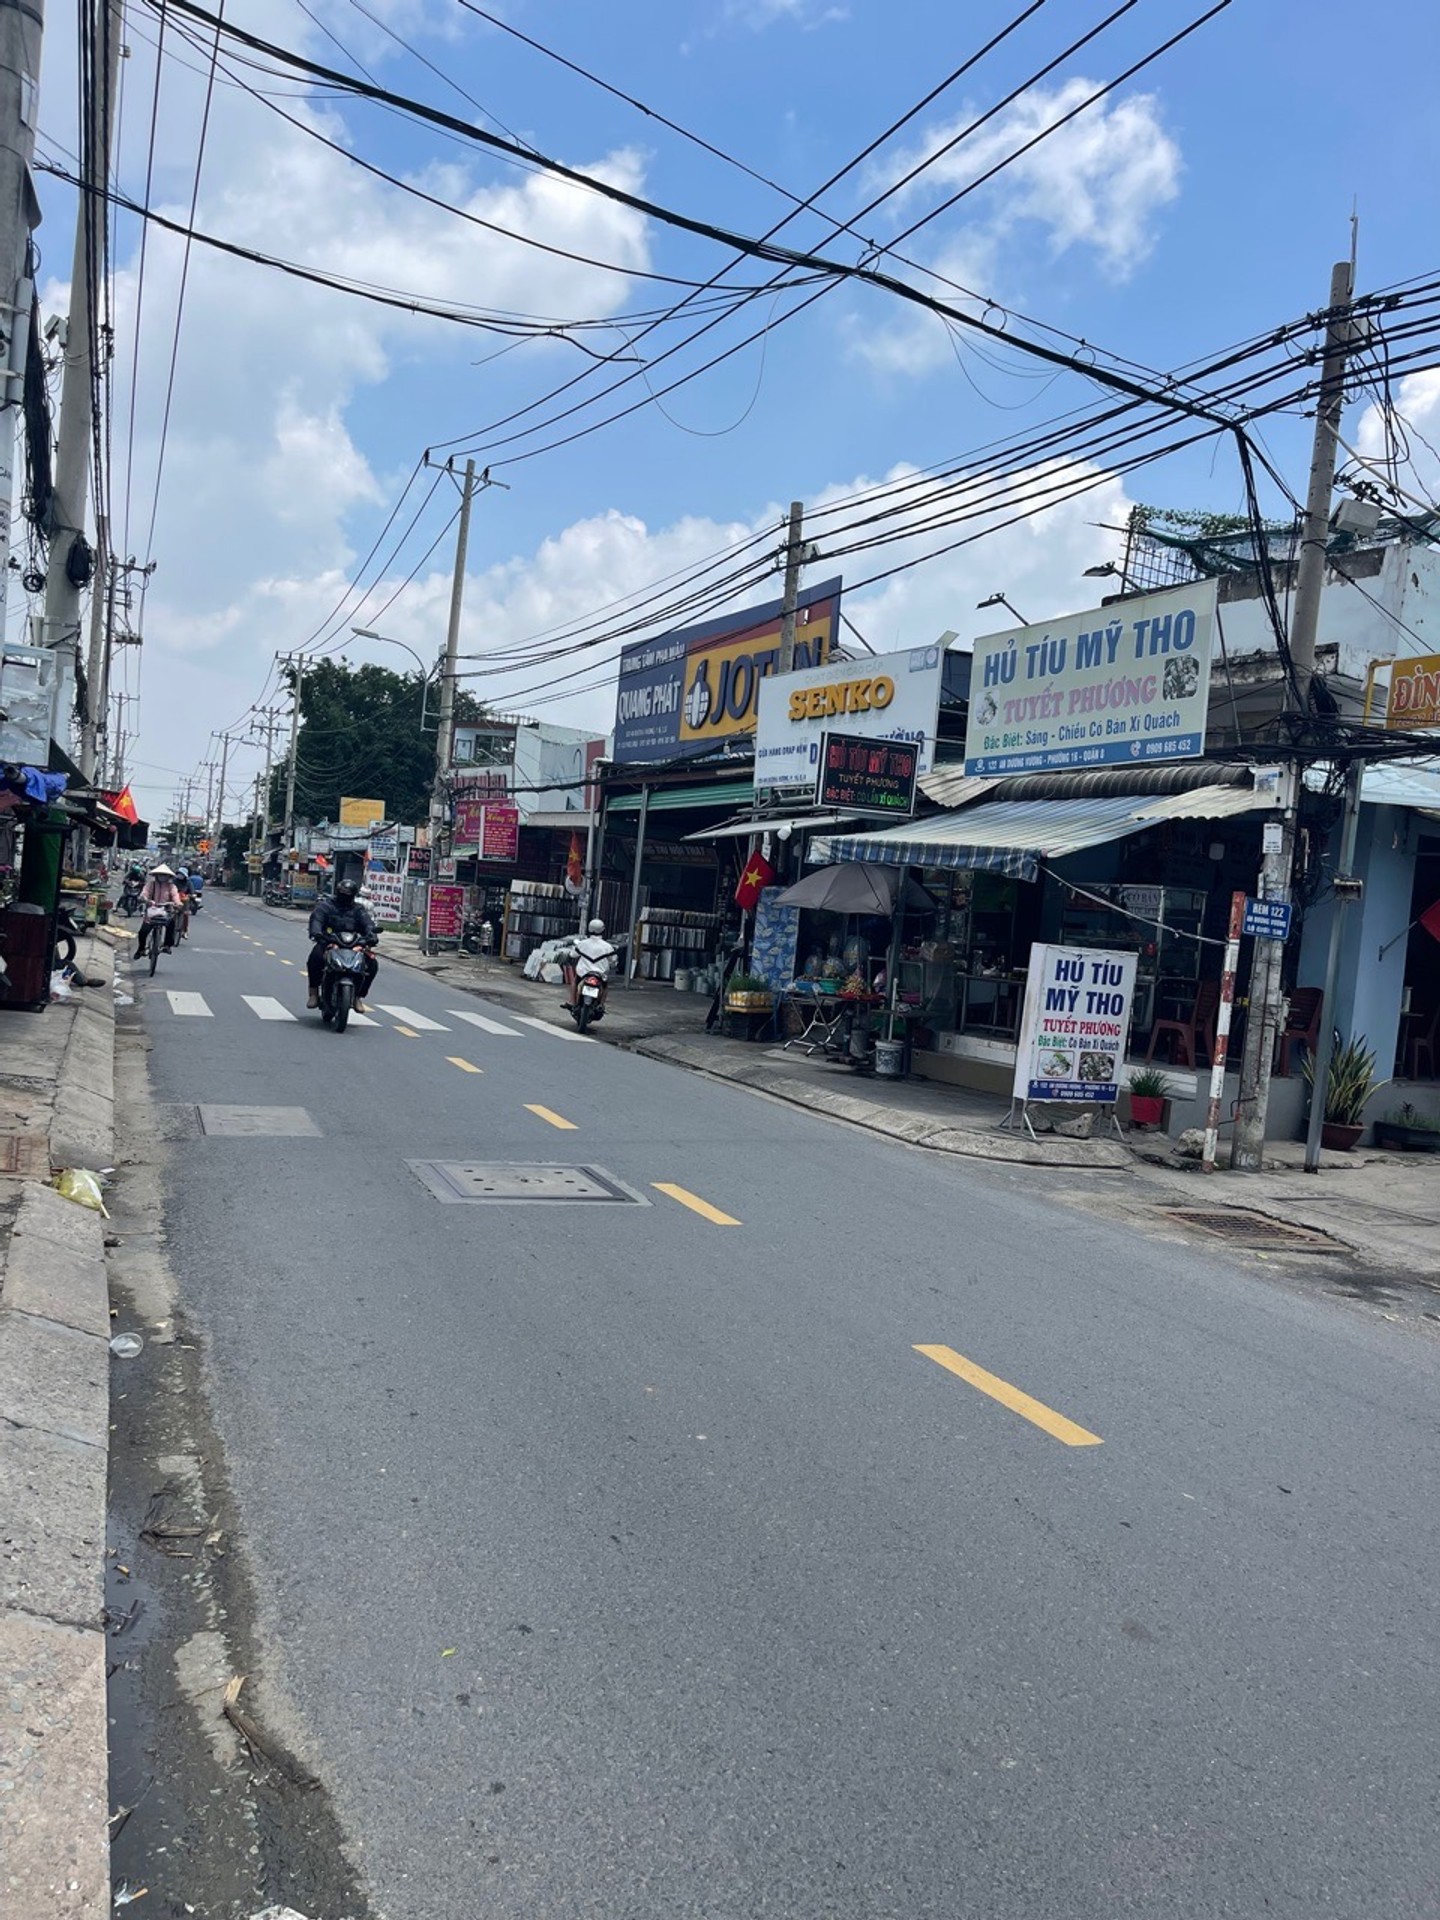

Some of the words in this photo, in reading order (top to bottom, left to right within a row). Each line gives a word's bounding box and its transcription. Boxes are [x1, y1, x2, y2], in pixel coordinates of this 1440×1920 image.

[984, 639, 1017, 687] HỦ
[1026, 634, 1066, 679] TÍU
[1076, 619, 1122, 670] MỸ
[1134, 609, 1196, 658] THO
[711, 636, 823, 726] JOTN
[619, 685, 652, 724] QUANG
[652, 674, 681, 715] PHÁT
[789, 675, 895, 721] SENKO
[1004, 681, 1064, 724] TUYẾT
[1067, 674, 1157, 715] PHƯƠNG
[984, 735, 1000, 750] Đặc
[1002, 732, 1023, 749] Biệt:
[1026, 729, 1048, 747] Sáng
[1089, 719, 1103, 736] Có
[1106, 716, 1127, 734] Bán
[1144, 710, 1180, 730] Quách
[869, 747, 888, 773] MỸ
[890, 753, 912, 777] THO
[1146, 743, 1162, 754] 0909
[999, 760, 1005, 768] AN
[839, 773, 863, 783] TUYẾT
[866, 777, 899, 788] PHƯƠNG
[1271, 907, 1285, 918] 122
[1055, 954, 1084, 983] HỦ
[1092, 960, 1123, 986] TÍU
[1045, 986, 1080, 1012] MỸ
[1086, 991, 1124, 1016] THO
[1038, 1035, 1050, 1046] Đặc
[1043, 1016, 1077, 1034] TUYẾT
[1080, 1020, 1121, 1036] PHƯƠNG
